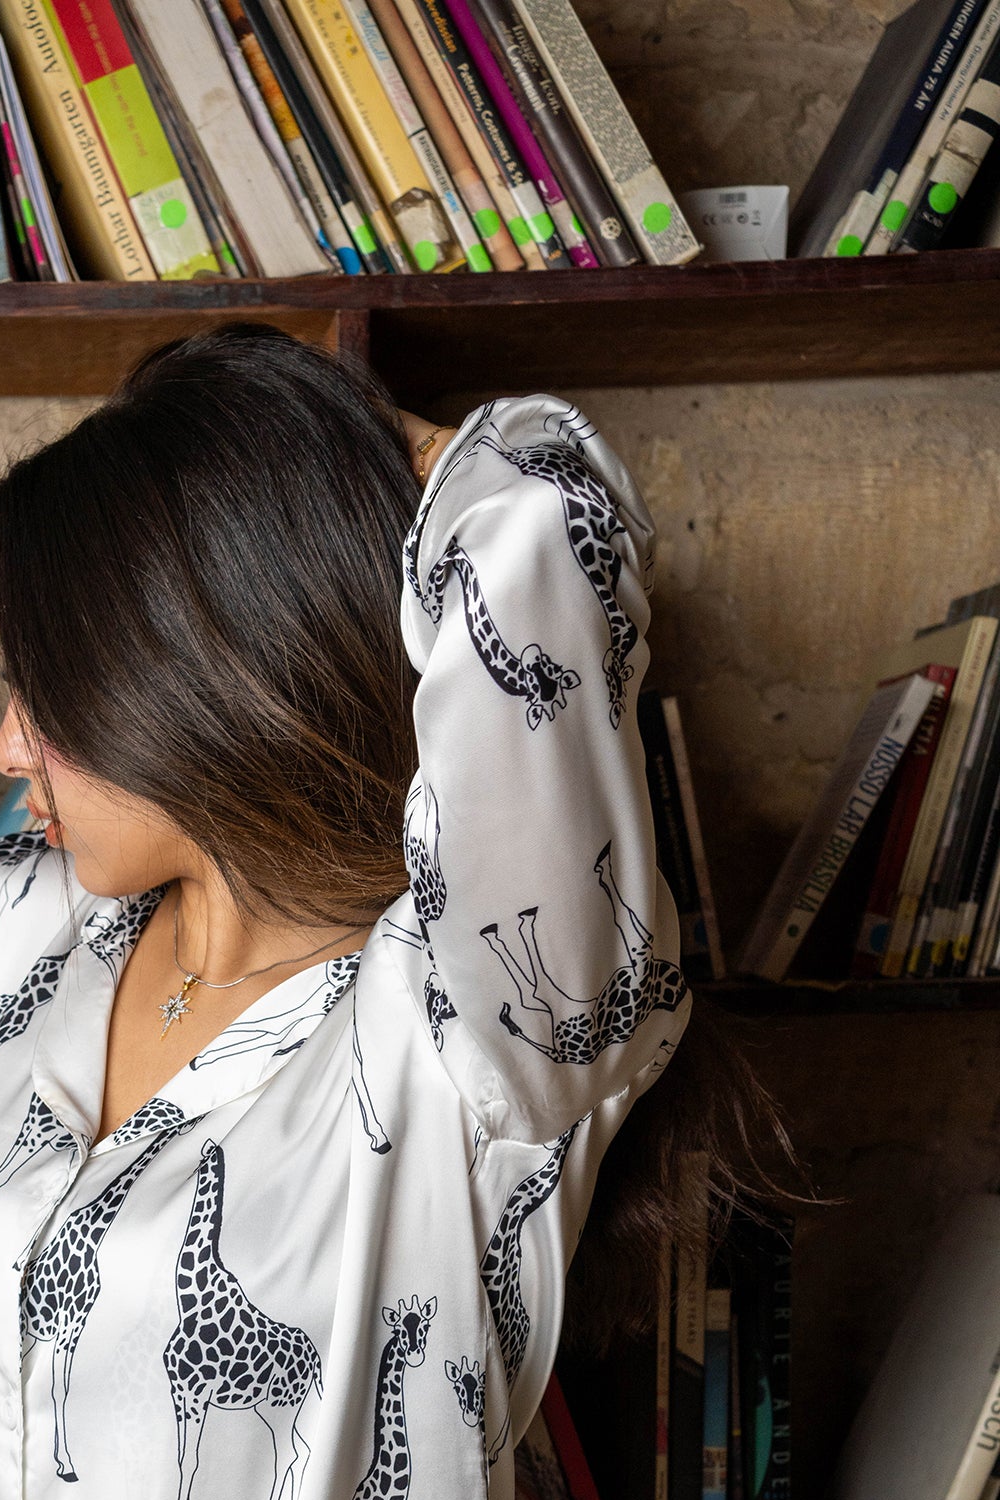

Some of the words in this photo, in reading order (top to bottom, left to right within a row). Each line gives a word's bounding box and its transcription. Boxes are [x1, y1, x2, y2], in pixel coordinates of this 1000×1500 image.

[502, 43, 549, 114] Covenant
[923, 75, 938, 90] 75
[931, 40, 955, 75] AURA
[454, 61, 490, 111] Patterns,
[477, 107, 516, 164] Costumes
[505, 159, 519, 173] &
[914, 92, 932, 112] ÅR
[58, 89, 118, 208] Baumgarten
[105, 209, 140, 278] Lothar
[859, 736, 904, 796] NOSSO
[837, 797, 871, 836] LAR
